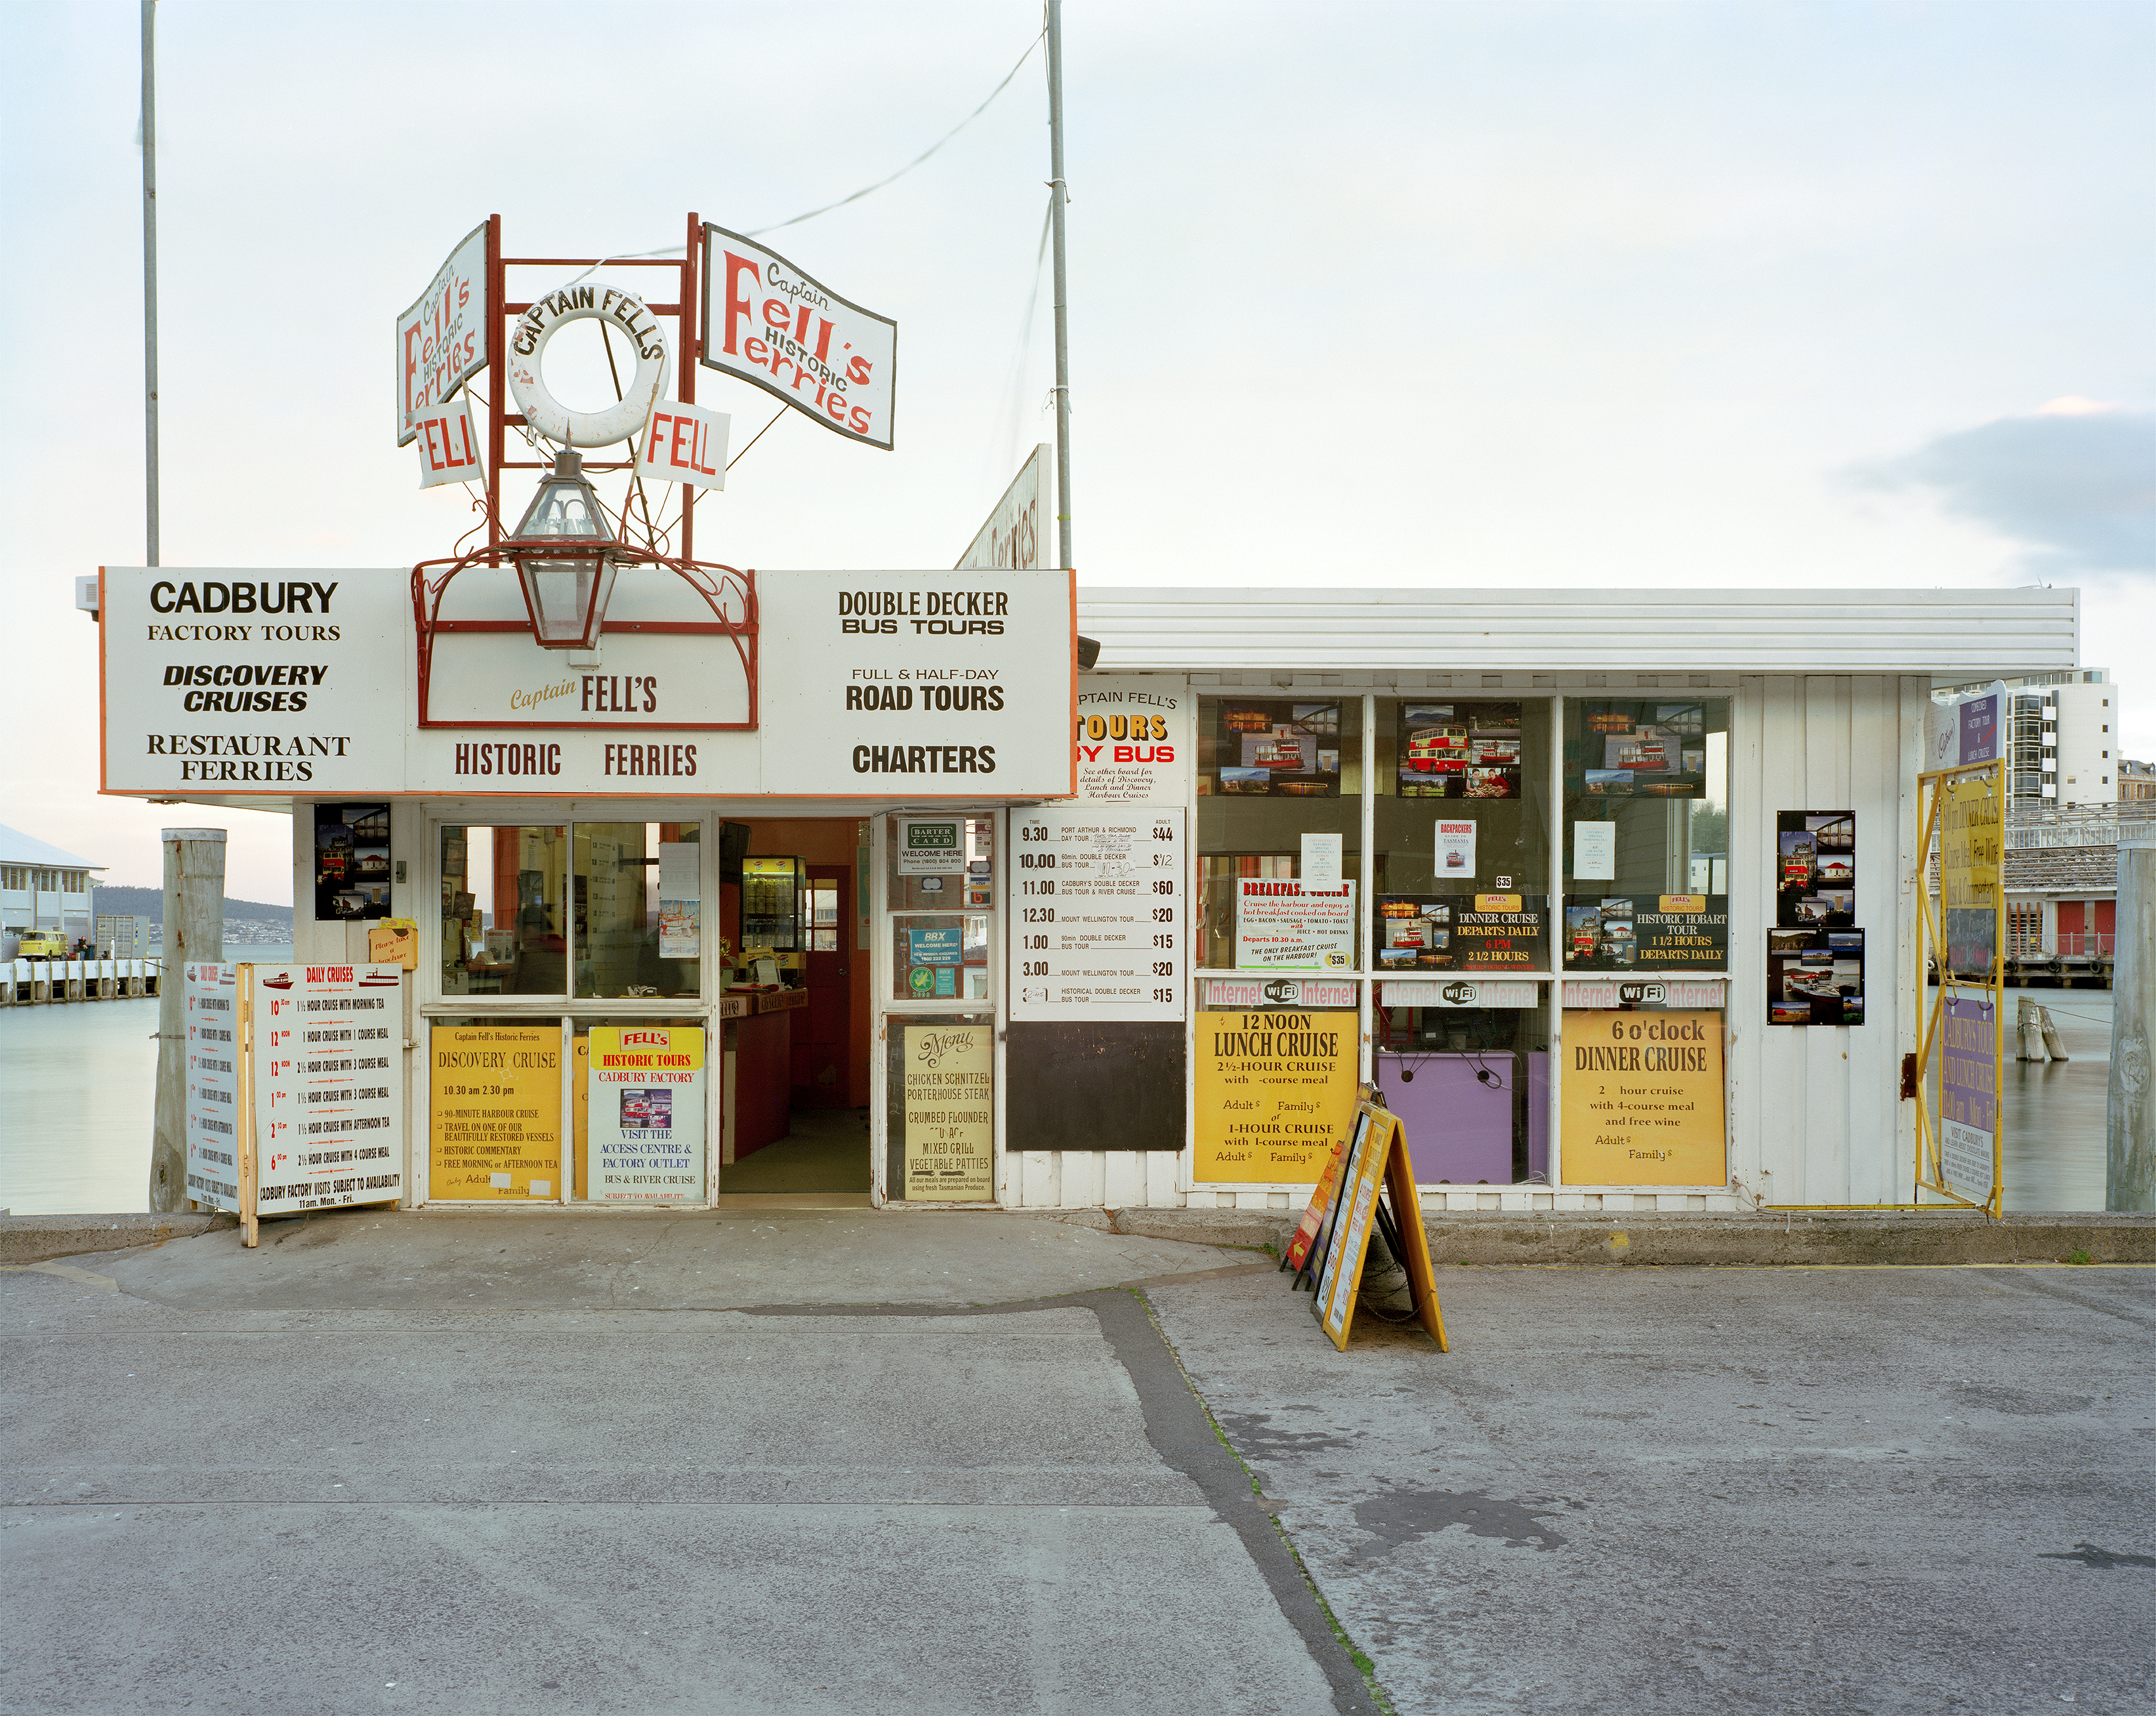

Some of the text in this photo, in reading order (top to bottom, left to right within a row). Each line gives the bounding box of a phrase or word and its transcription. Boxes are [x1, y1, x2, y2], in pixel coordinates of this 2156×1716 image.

[767, 262, 831, 311] Captain
[424, 264, 455, 326] Captain
[514, 287, 664, 360] CAPTAIN FELL'S
[724, 250, 873, 386] Fell's
[424, 313, 463, 383] HISTORIC
[765, 327, 848, 392] HISTORIC
[647, 412, 716, 475] FELL
[151, 582, 338, 613] CADBURY
[838, 591, 1008, 615] DOUBLE DECKER
[148, 625, 340, 641] FACTORY TOURS
[842, 619, 1004, 634] BUS TOURS
[164, 665, 328, 686] DISCOVERY
[853, 670, 999, 679] FULL & HALF-DAY
[184, 691, 307, 712] CRUISES
[511, 676, 657, 712] Captain FELL'S
[847, 686, 1004, 711] ROAD TOURS
[1077, 692, 1177, 709] PTAIN FELL'S
[1972, 700, 1986, 713] COMBINED
[1077, 715, 1167, 741] TOURS
[1968, 717, 1980, 729] FACTORY
[147, 734, 350, 756] RESTAURANT
[455, 743, 697, 776] HISTORIC FERRIES
[853, 745, 996, 773] CHARTERS
[1114, 746, 1174, 762] BUS
[181, 761, 312, 781] FERRIES
[1141, 768, 1152, 776] for
[1441, 824, 1472, 833] BACKPACKERS
[1023, 881, 1054, 895] 11.00
[1153, 881, 1172, 895] $60
[1496, 876, 1511, 888] $35
[1023, 908, 1054, 922] 12.30
[1153, 908, 1172, 922] $20
[1458, 914, 1537, 923] DINNER CRUISE
[1637, 914, 1727, 924] HISTORIC HOBART
[925, 932, 946, 941] BBX
[1458, 926, 1539, 936] DEPARTS DAILY
[1667, 925, 1698, 935] TOUR
[1332, 956, 1344, 964] $35
[307, 966, 353, 983] DAILY CRUISES
[1209, 980, 1262, 1004] Internet
[1302, 982, 1354, 1005] Internet
[1243, 1015, 1311, 1030] 12 NOON
[1612, 1019, 1705, 1040] 6 o'clock
[271, 1031, 278, 1046] 12
[304, 1032, 305, 1042] 1
[308, 1031, 321, 1042] HOUR
[323, 1030, 338, 1042] CRUISE
[340, 1030, 351, 1040] WITH
[354, 1030, 356, 1040] 1
[358, 1028, 375, 1040] COURSE
[377, 1028, 388, 1039] MEAL
[455, 1032, 539, 1042] Captain Fell's Historic Ferries
[1214, 1032, 1338, 1056] LUNCH CRUISE
[918, 1031, 973, 1068] Menu
[439, 1052, 556, 1068] DISCOVERY CRUISE
[603, 1054, 690, 1066] HISTORIC TOURS
[1575, 1047, 1707, 1072] DINNER CRUISE
[599, 1072, 695, 1082] CADBURY FACTORY
[908, 1073, 989, 1085] CHICKEN SCHNITZEL
[444, 1085, 466, 1094] 10.30
[483, 1085, 500, 1094] 2.30
[503, 1088, 513, 1096] pm
[908, 1089, 989, 1101] PORTERHOUSE STEAK
[621, 1130, 672, 1139] VISIT THE
[1951, 1126, 1983, 1147] VISIT CADBURY'S
[444, 1146, 521, 1155] HISTORIC COMMENTARY
[600, 1144, 692, 1153] ACCESS CENTRE &
[923, 1143, 973, 1155] MIXED GRILL
[603, 1159, 690, 1168] FACTORY OUTLET
[260, 1174, 400, 1201] CADBURY FACTORY VISITS SUBJECT TO AVAILABILITY
[299, 1200, 318, 1208] 11am.
[321, 1197, 337, 1206] Mon.
[343, 1195, 354, 1203] Fri.
